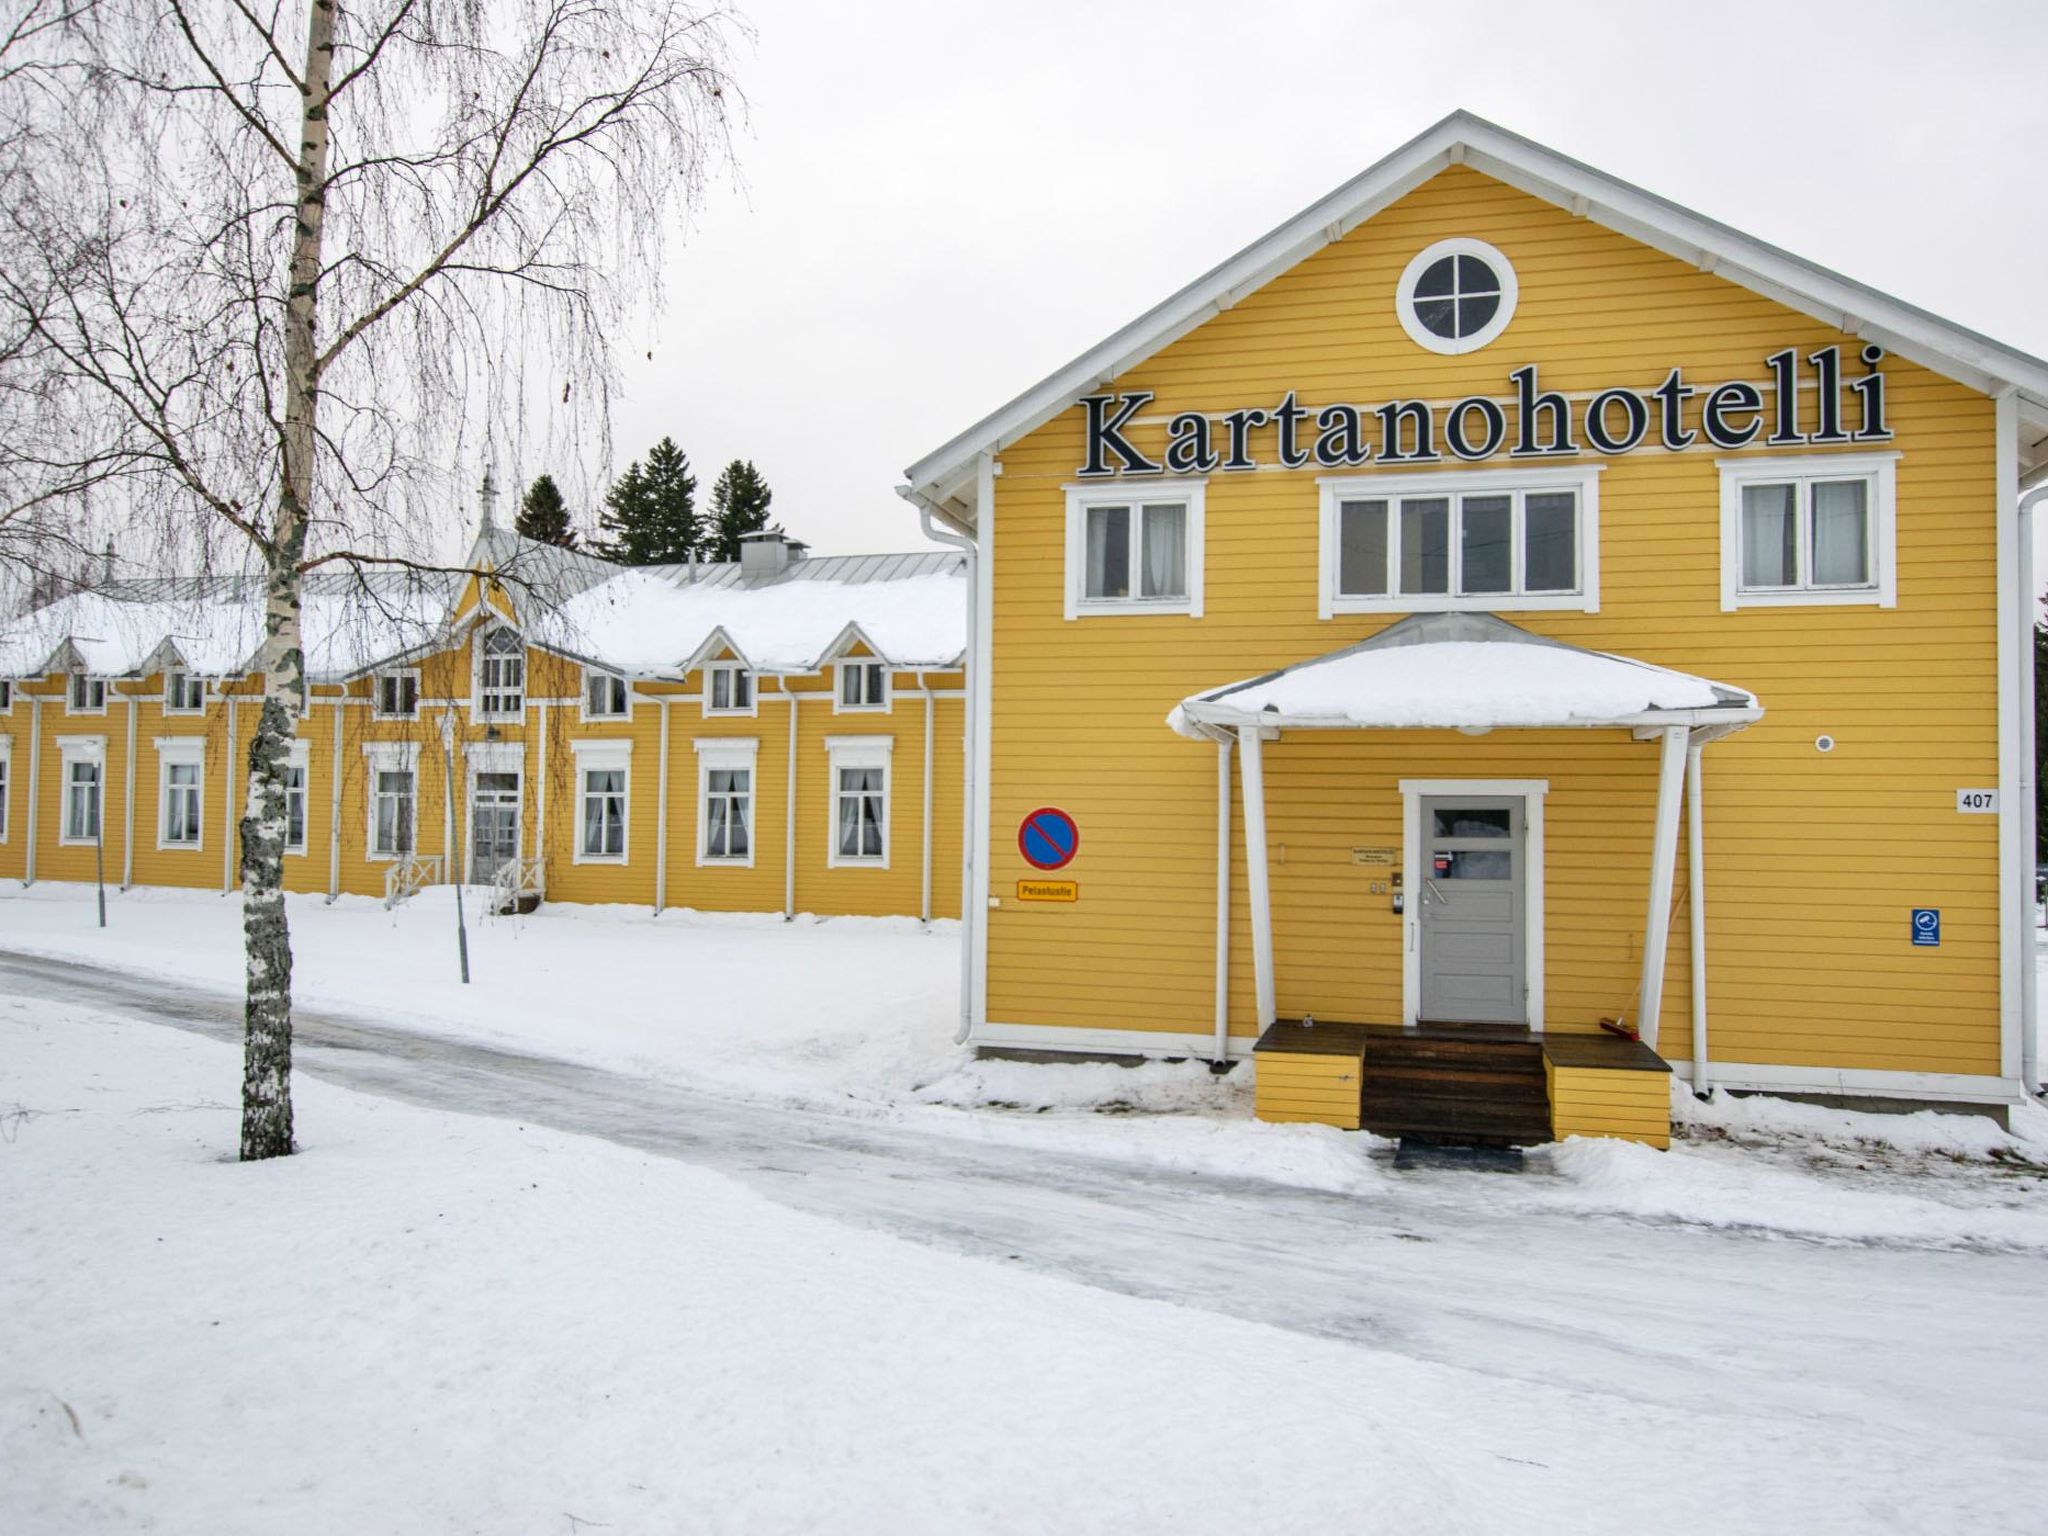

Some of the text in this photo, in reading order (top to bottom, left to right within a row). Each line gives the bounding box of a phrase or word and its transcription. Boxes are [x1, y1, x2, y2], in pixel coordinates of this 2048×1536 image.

[1076, 344, 1894, 478] Kartanohotelli
[1962, 794, 1993, 808] 407
[1022, 885, 1073, 897] Pelastustie
